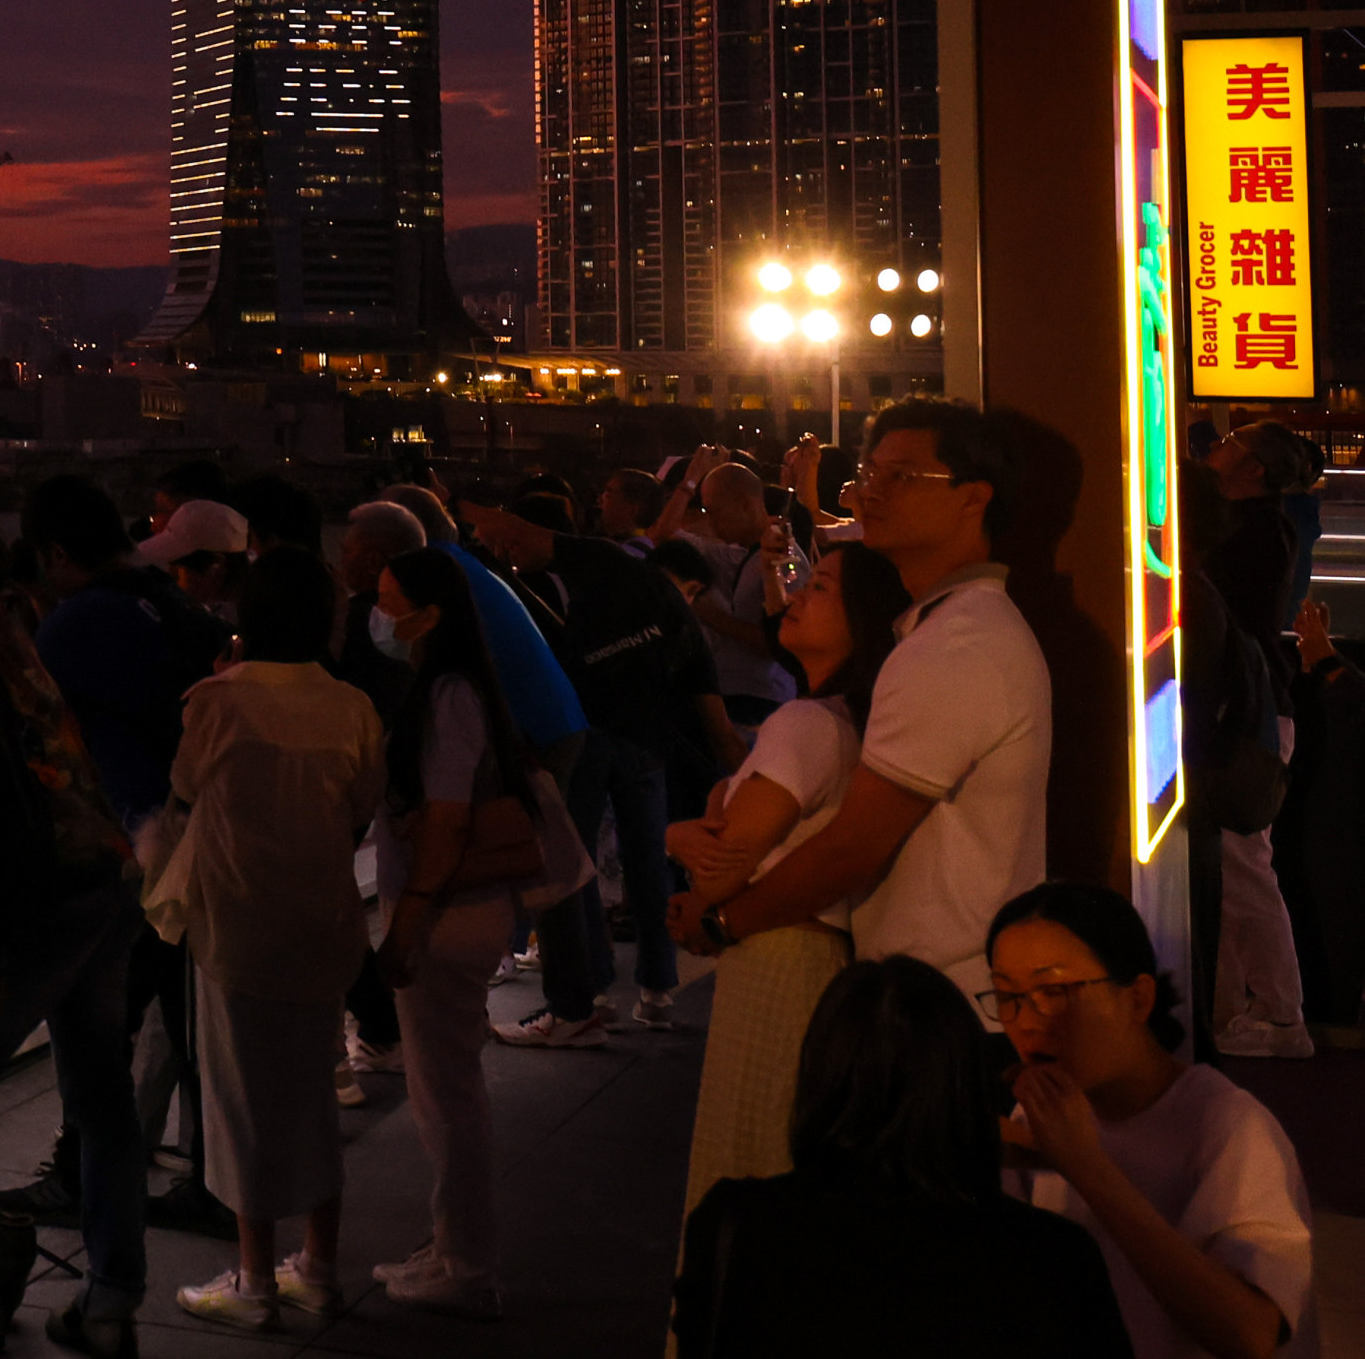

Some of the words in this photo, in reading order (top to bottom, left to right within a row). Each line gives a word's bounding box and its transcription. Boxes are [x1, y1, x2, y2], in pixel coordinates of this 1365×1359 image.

[1226, 62, 1299, 370] 美麗雜貨
[1195, 221, 1217, 290] Grocer
[1197, 296, 1222, 368] Beauty
